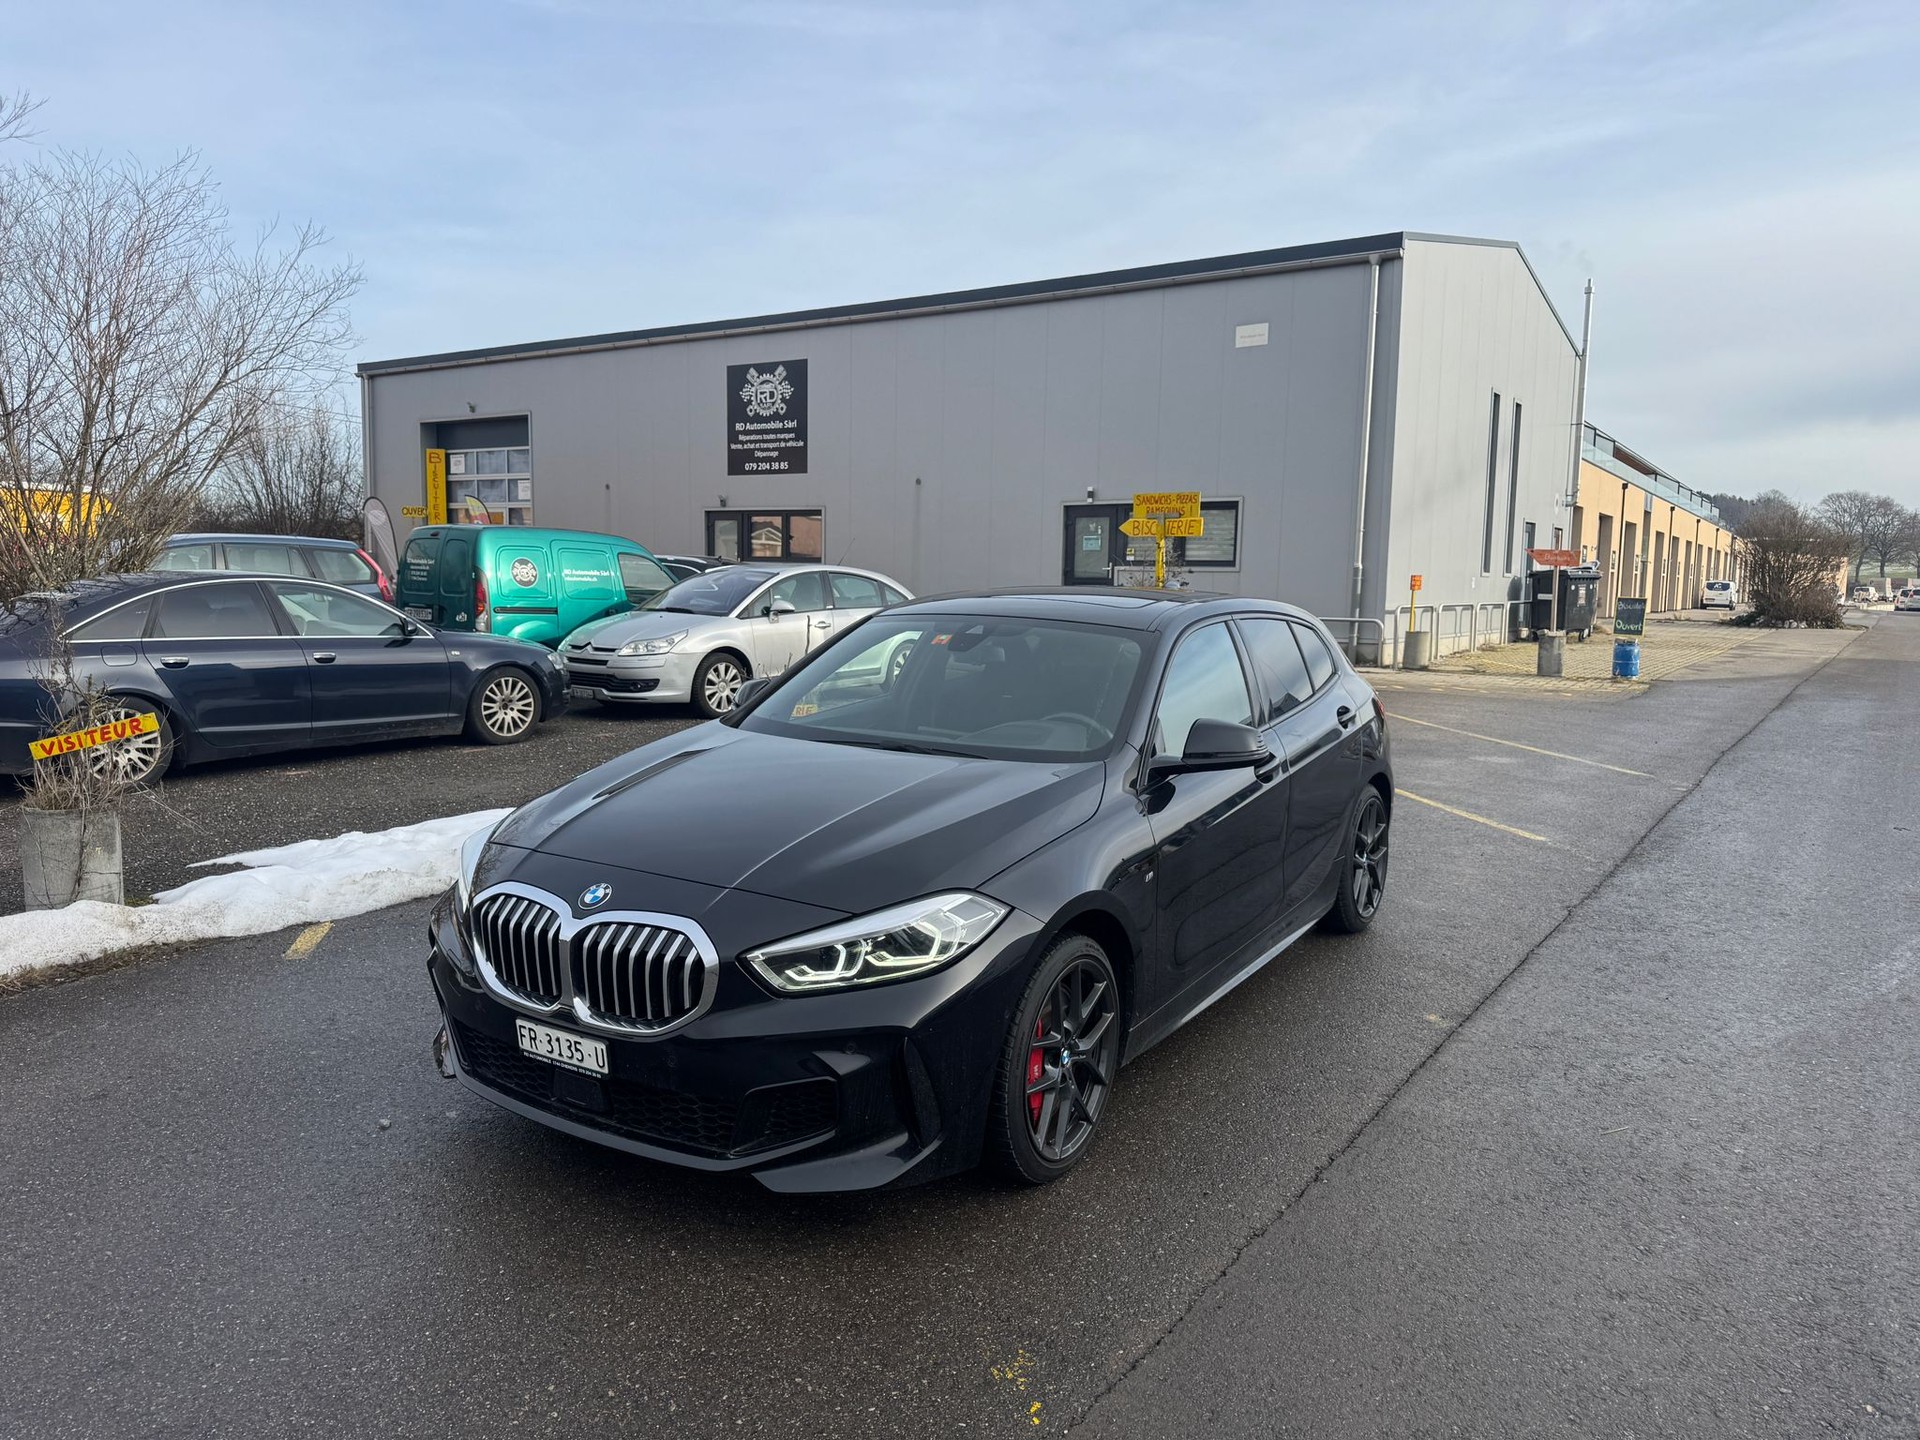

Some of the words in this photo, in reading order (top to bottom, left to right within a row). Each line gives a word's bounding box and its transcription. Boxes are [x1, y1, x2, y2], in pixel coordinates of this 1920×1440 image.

[735, 422, 745, 431] RD
[746, 421, 783, 431] Automobile
[784, 419, 797, 429] Sàrl
[754, 450, 779, 458] Dépannage
[744, 462, 757, 471] 079
[758, 462, 770, 470] 204
[771, 462, 779, 470] 38
[780, 461, 789, 470] 85
[1176, 494, 1198, 504] PIZZAS
[1132, 519, 1197, 536] BISCTERIE
[1616, 619, 1642, 631] Ouvert
[39, 717, 144, 757] VISITEUR
